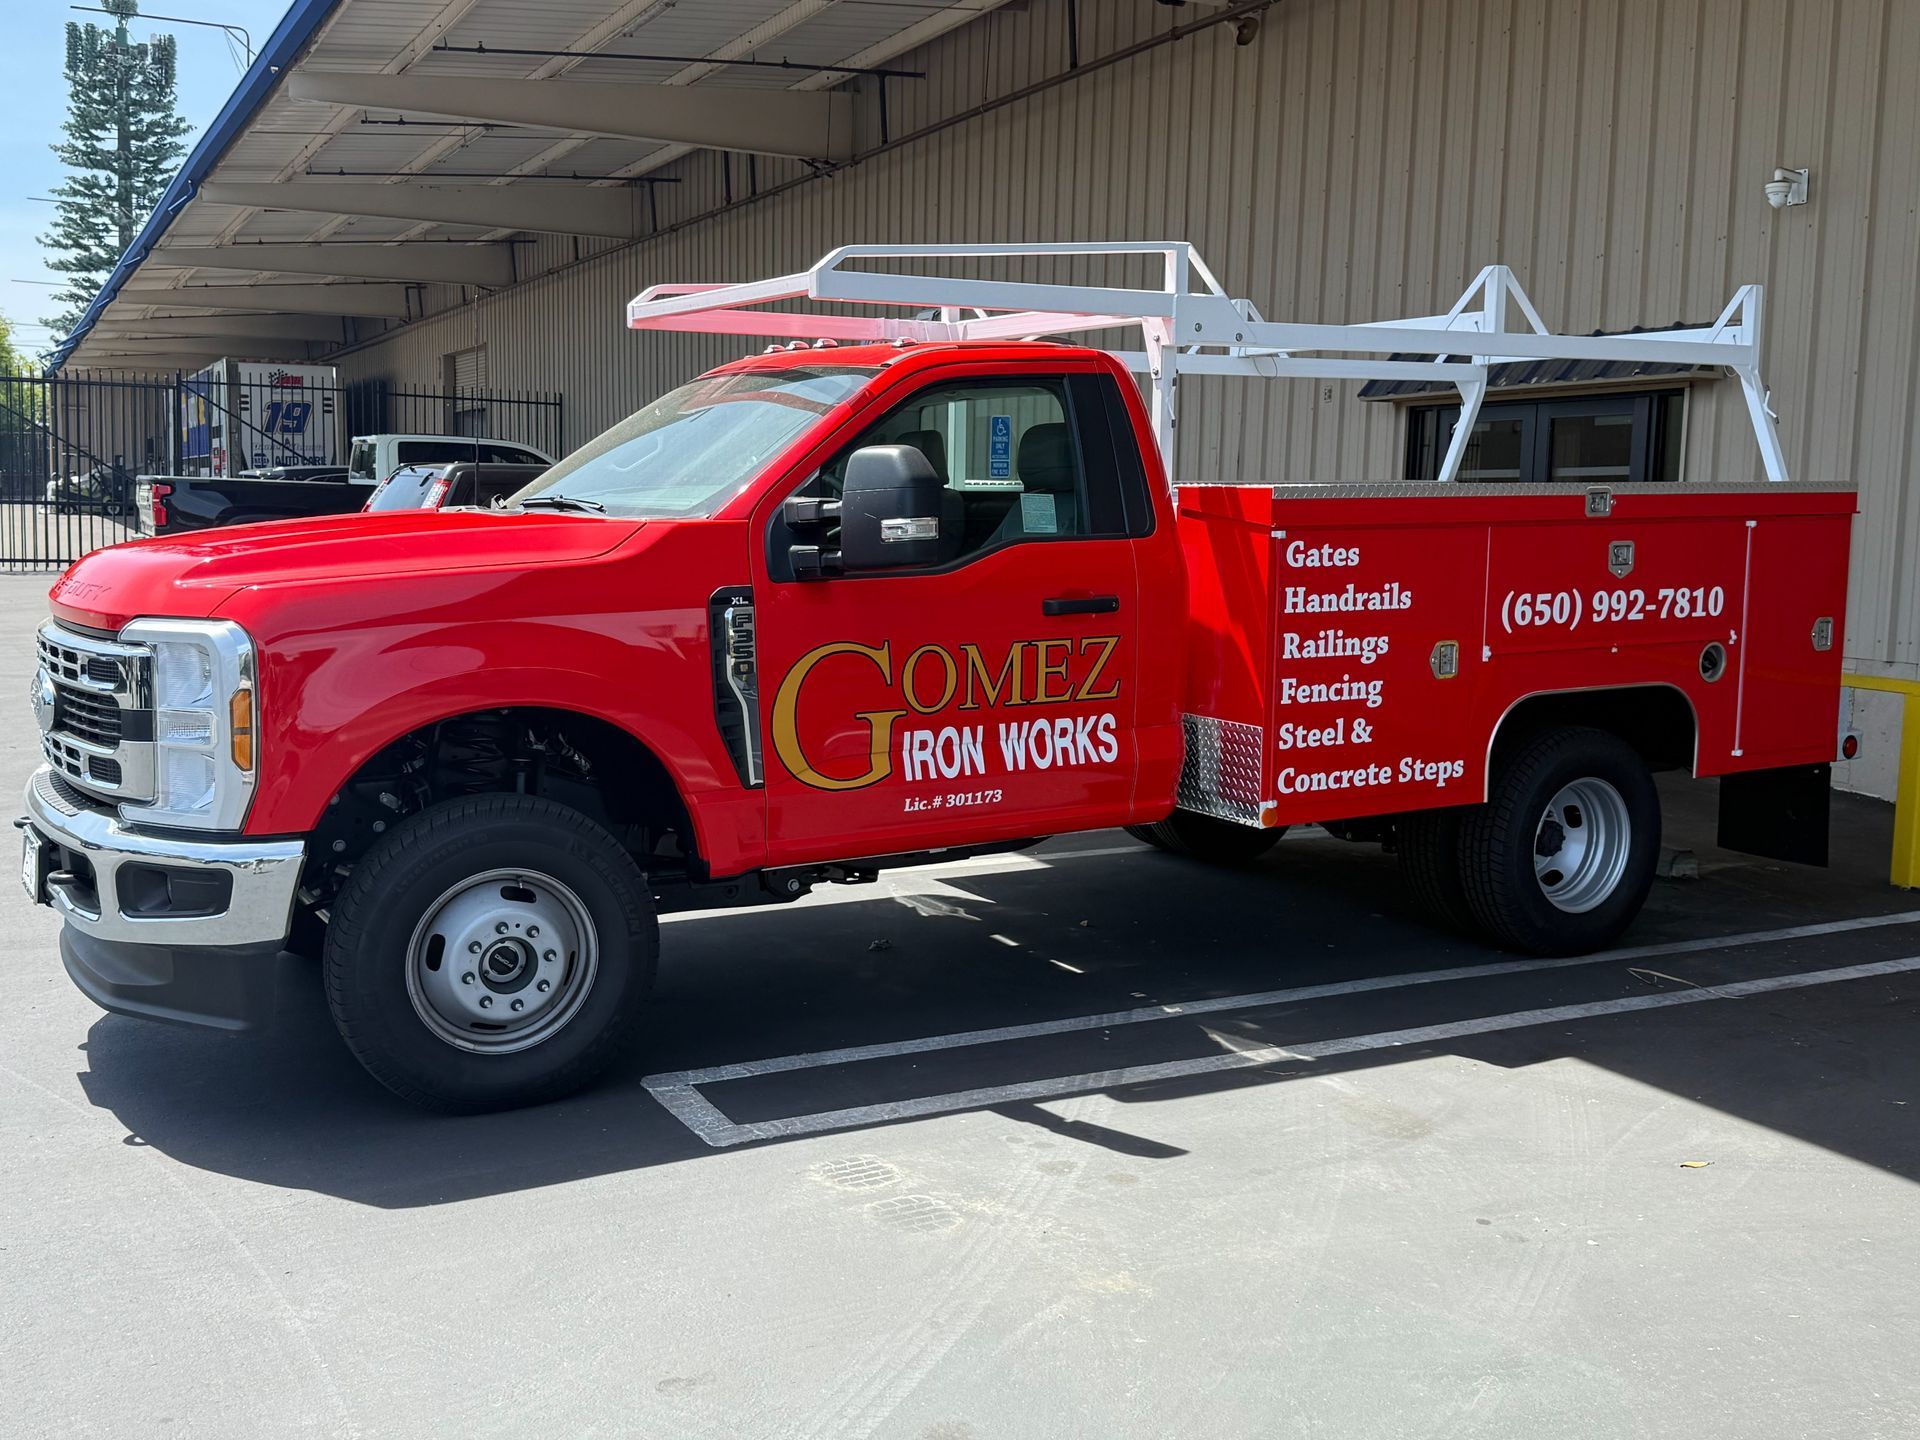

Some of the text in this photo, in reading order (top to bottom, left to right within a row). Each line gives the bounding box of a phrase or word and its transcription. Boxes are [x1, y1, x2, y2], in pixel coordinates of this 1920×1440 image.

[263, 401, 312, 434] 19
[275, 456, 299, 466] AUTO
[302, 456, 327, 466] CARE
[1286, 540, 1360, 568] Gates
[731, 596, 749, 605] XL
[1284, 582, 1412, 614] Handrails
[1501, 586, 1724, 634] (650) 992-7810
[734, 613, 754, 675] F350
[1282, 629, 1389, 665] Railings
[1280, 673, 1384, 708] Fencing
[771, 635, 1121, 792] GOMEZ
[902, 712, 1119, 782] IRON WORKS
[1278, 717, 1373, 750] Steel &
[1277, 757, 1464, 795] Concrete Steps
[903, 789, 1003, 812] Lic.# 301173
[494, 953, 514, 968] FORD
